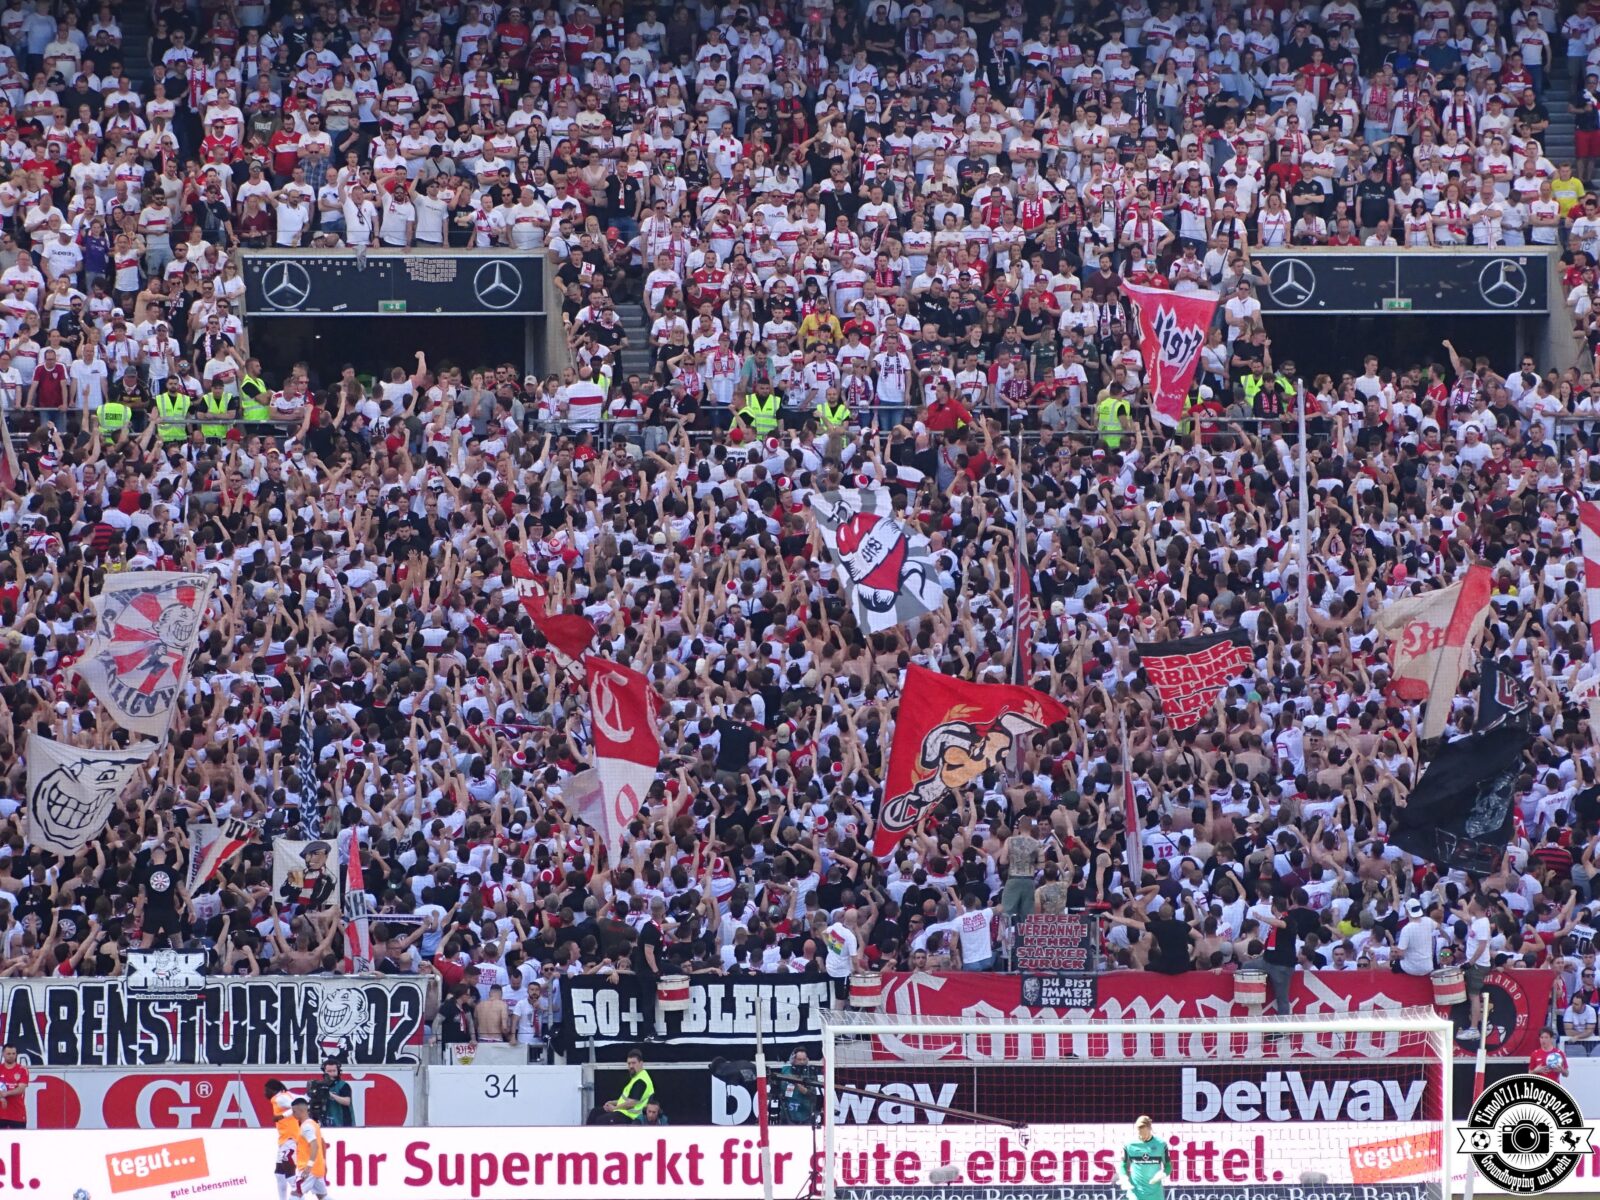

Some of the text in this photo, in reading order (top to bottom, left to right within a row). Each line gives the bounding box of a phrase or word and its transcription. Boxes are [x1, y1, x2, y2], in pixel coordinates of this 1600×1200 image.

[1142, 640, 1232, 669] EDER
[1147, 646, 1254, 686] RBANNTE
[1158, 845, 1173, 858] 12
[1025, 914, 1080, 924] JEDER
[1017, 923, 1088, 937] VERBANNTE
[1023, 937, 1081, 947] KEHRT
[1042, 978, 1093, 988] DU BIST
[1042, 988, 1092, 998] IMMER
[1042, 998, 1093, 1006] BEI UNS!
[484, 1074, 519, 1098] 34
[1181, 1067, 1428, 1123] betway
[404, 1139, 705, 1198] Supermarkt
[940, 1135, 1285, 1186] Lebensittel.
[170, 1176, 248, 1198] gute Lebensmittel
